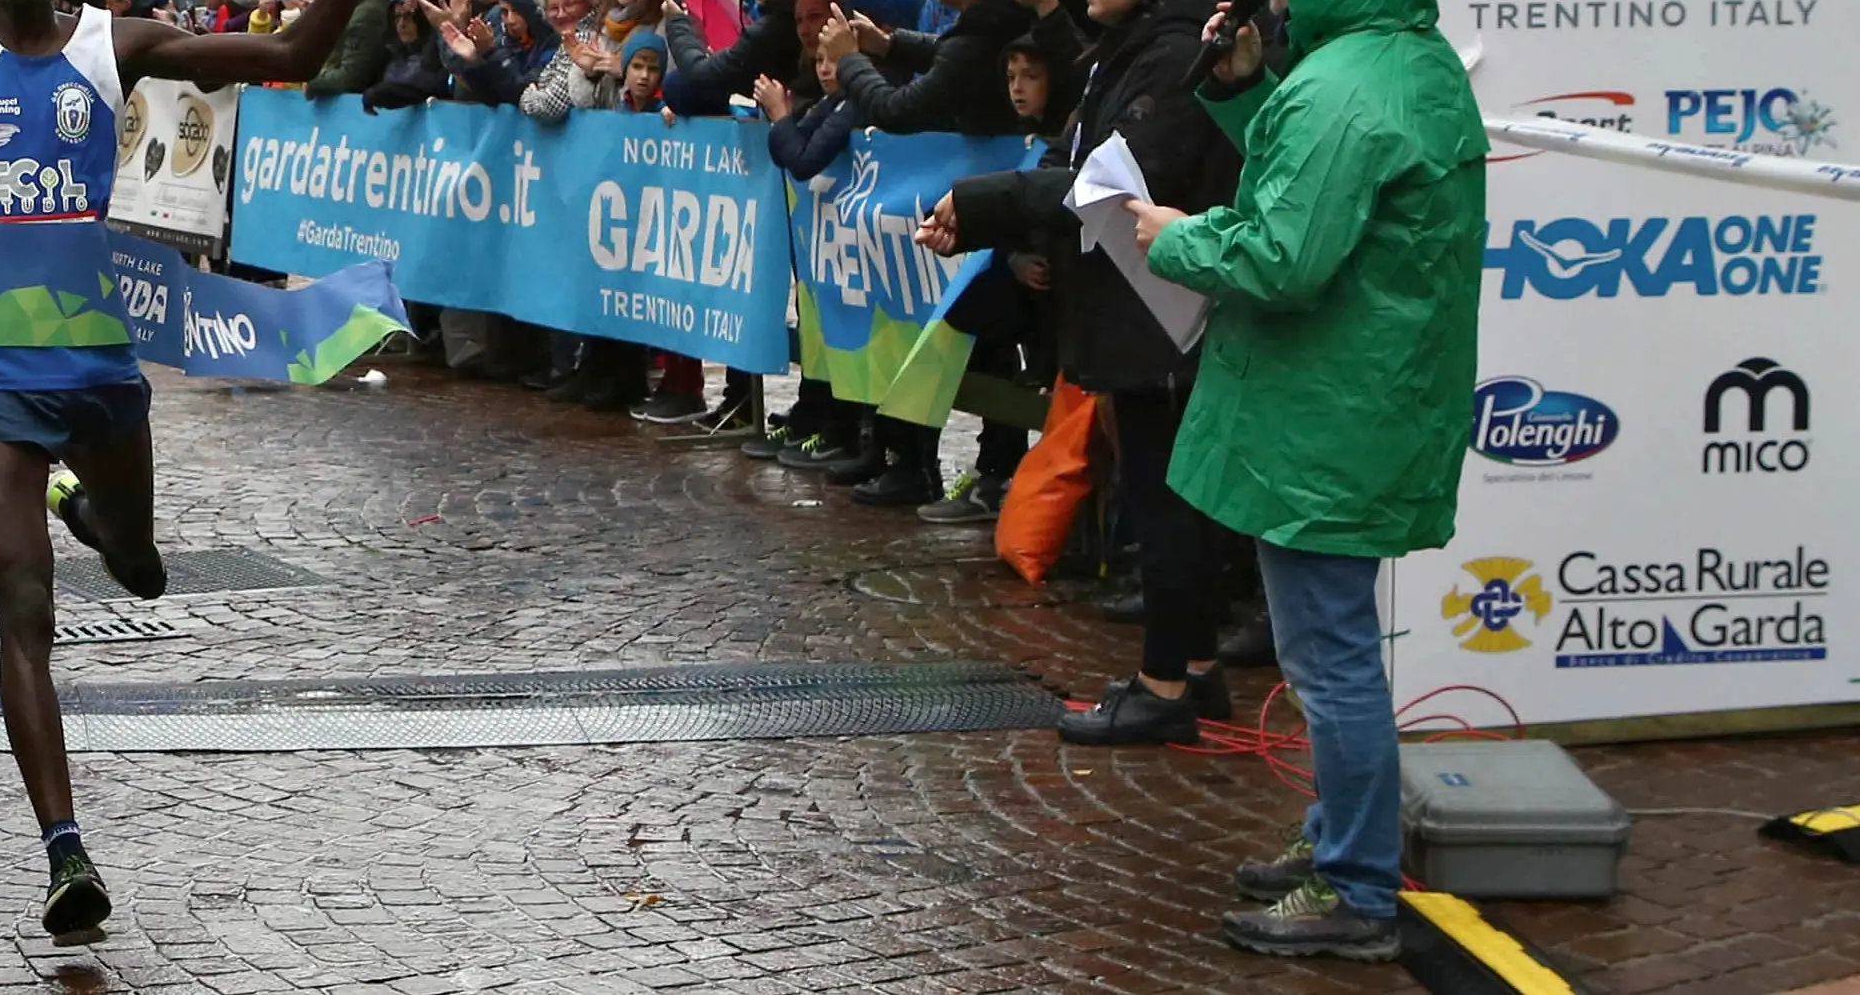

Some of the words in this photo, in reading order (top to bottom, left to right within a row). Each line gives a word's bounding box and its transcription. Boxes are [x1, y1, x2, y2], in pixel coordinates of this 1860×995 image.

[1468, 3, 1687, 29] TRENTINO
[1710, 0, 1818, 26] ITALY
[1665, 88, 1798, 143] PEJO
[241, 126, 540, 228] gardatrentino.it
[623, 137, 694, 170] NORTH
[296, 218, 400, 261] #GardaTrentino
[589, 180, 757, 294] GARDA
[808, 175, 969, 315] TRENTIN
[1482, 217, 1717, 300] HOKA
[1714, 215, 1816, 253] ONE
[137, 259, 163, 275] LAKE
[1721, 256, 1822, 294] ONE
[116, 274, 168, 324] RDA
[600, 288, 694, 332] TRENTINO
[704, 308, 743, 343] ITALY
[184, 311, 256, 359] NTINO
[1475, 375, 1605, 459] Polenghi
[1703, 439, 1809, 473] mico
[1559, 551, 1686, 595] Cassa
[1697, 546, 1829, 592] Rurale
[1555, 607, 1657, 651] Alto
[1690, 602, 1825, 646] Garda
